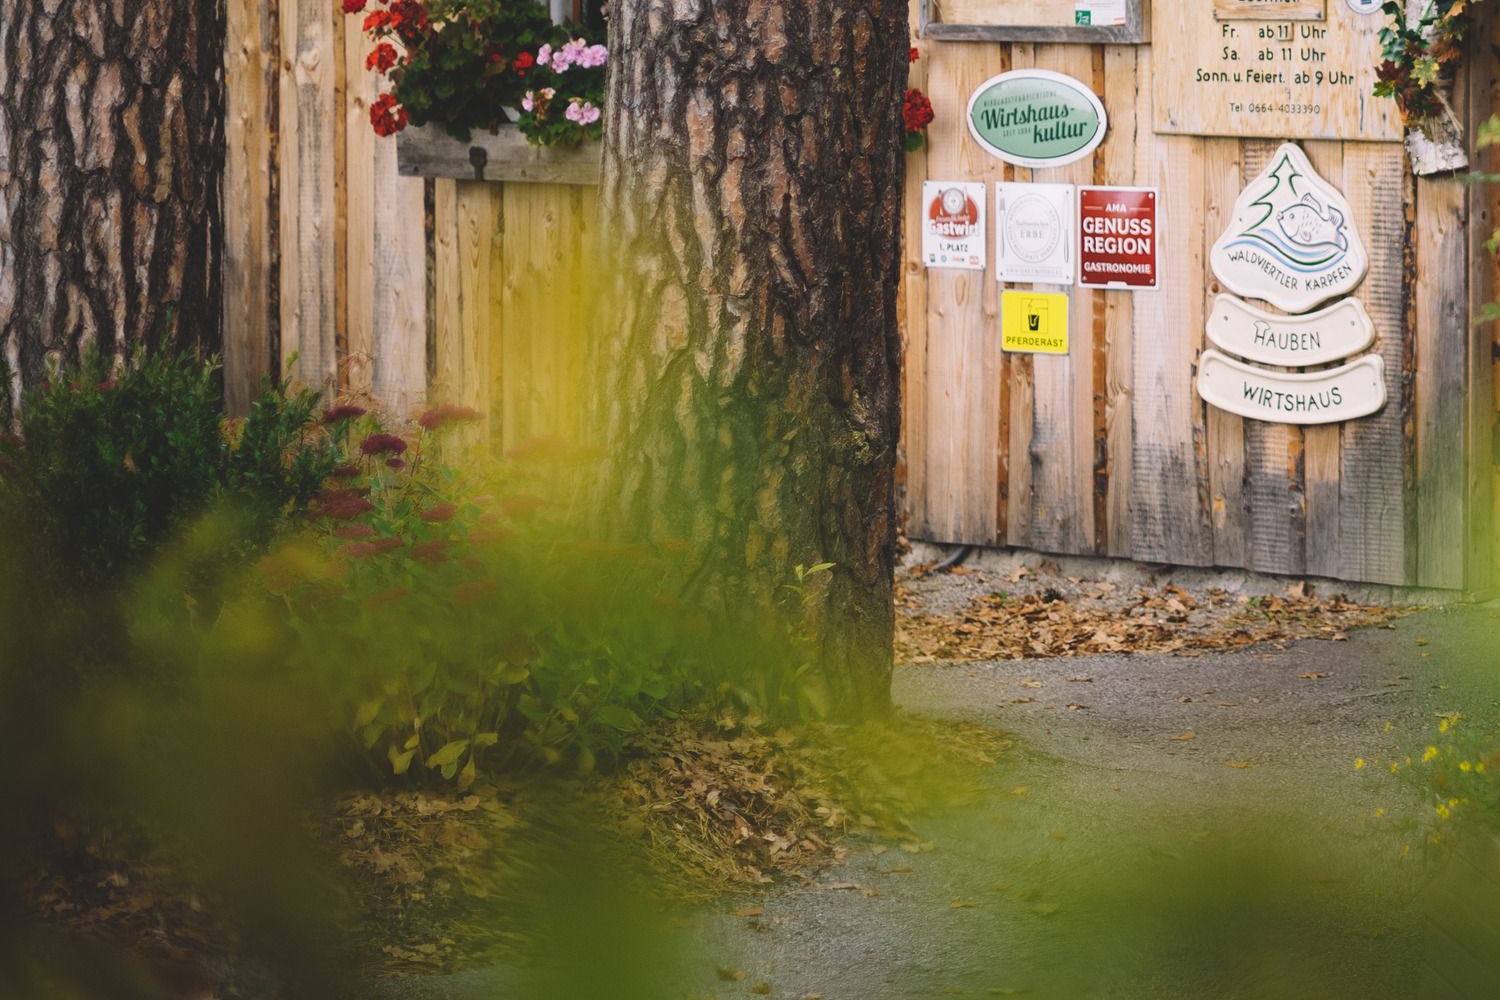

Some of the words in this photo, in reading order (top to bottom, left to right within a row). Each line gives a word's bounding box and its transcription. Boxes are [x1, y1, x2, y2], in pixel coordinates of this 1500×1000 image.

[1222, 24, 1240, 38] Fr.
[1258, 24, 1274, 38] ab
[1277, 25, 1289, 38] 11
[1301, 24, 1327, 39] Uhr
[1222, 46, 1240, 61] Sa.
[1258, 47, 1274, 61] ab
[1281, 48, 1292, 61] 11
[1300, 47, 1327, 62] Uhr
[1196, 68, 1230, 82] Sonn.
[1233, 73, 1243, 83] u.
[1246, 69, 1286, 84] Feiert.
[1294, 70, 1310, 84] ab
[1315, 70, 1324, 85] 9
[1328, 71, 1354, 85] Uhr
[1033, 121, 1088, 144] kultur
[1105, 203, 1127, 213] AMA
[1082, 216, 1152, 237] GENUSS
[946, 243, 968, 253] PLATZ
[1083, 236, 1151, 255] REGION
[1083, 261, 1151, 275] GASTRONOMIE
[1228, 249, 1299, 291] WALDVIERTLER
[1304, 262, 1353, 292] KARPFEN
[1005, 335, 1064, 348] PFERDERAST
[1253, 329, 1321, 351] HAUBEN
[1243, 381, 1343, 412] WIRTSHAUS
